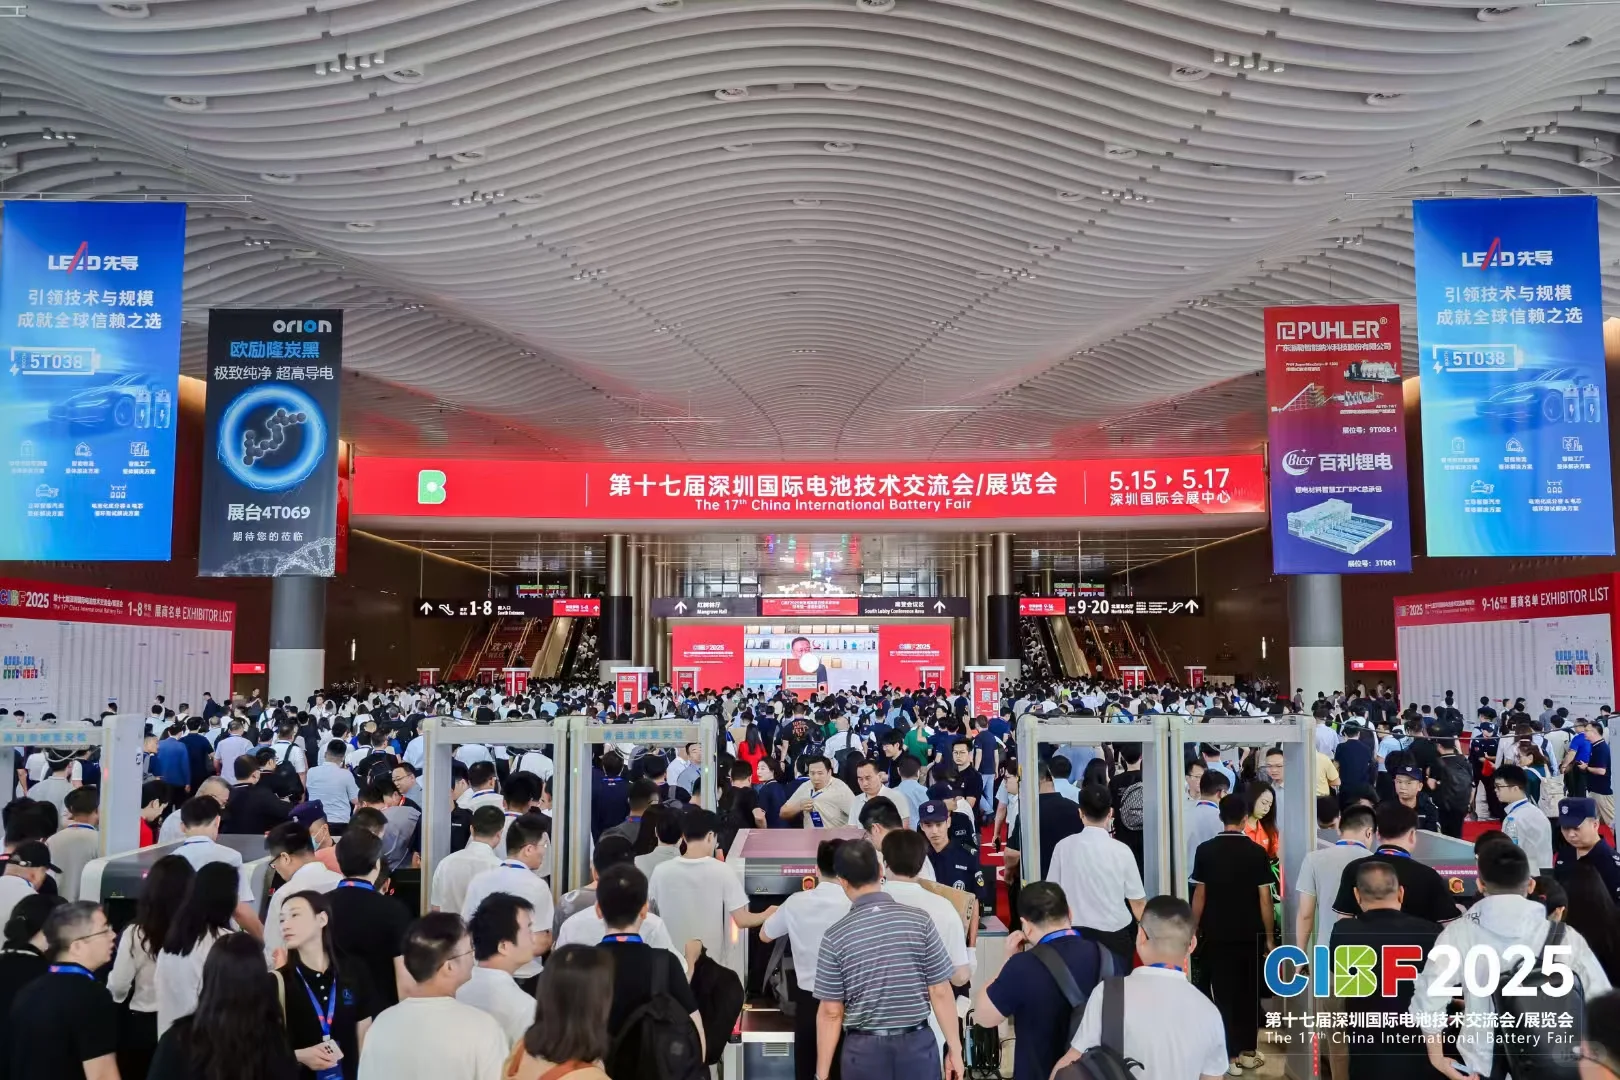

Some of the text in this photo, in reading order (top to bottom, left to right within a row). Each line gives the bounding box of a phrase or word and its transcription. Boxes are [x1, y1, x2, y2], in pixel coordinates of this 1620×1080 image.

[103, 255, 139, 271] 先导
[1518, 250, 1553, 266] 先导
[28, 289, 154, 306] 引领技术与规模
[1445, 285, 1573, 303] 引领技术与规模
[17, 312, 162, 329] 成就全球信赖之选
[1437, 307, 1583, 326] 成就全球信赖之选
[230, 341, 320, 358] 欧励隆炭黑
[30, 354, 82, 369] 5T038
[1452, 351, 1505, 366] 5T038
[213, 366, 334, 381] 极致纯净 超高导电
[1318, 453, 1393, 472] 百利锂电
[609, 471, 1057, 498] 第十七届深圳国际电池技术交流会/展览会
[1109, 468, 1230, 491] 5.15 5.17
[695, 499, 720, 511] The
[751, 499, 791, 511] China
[795, 499, 884, 511] International
[889, 499, 940, 512] Battery
[946, 498, 972, 509] Fair
[1109, 491, 1231, 506] 深圳国际会展中心
[227, 503, 311, 521] 展台4T069
[232, 531, 304, 542] 期待您的莅临
[1481, 597, 1500, 611] 9-16
[1510, 586, 1610, 608] 展商名单 EXHIBITOR LIST
[128, 601, 143, 617] 1-8
[155, 604, 233, 623] 展商名单 EXHIBITOR LIST
[469, 600, 492, 616] 1-8
[1077, 600, 1110, 614] 9-20
